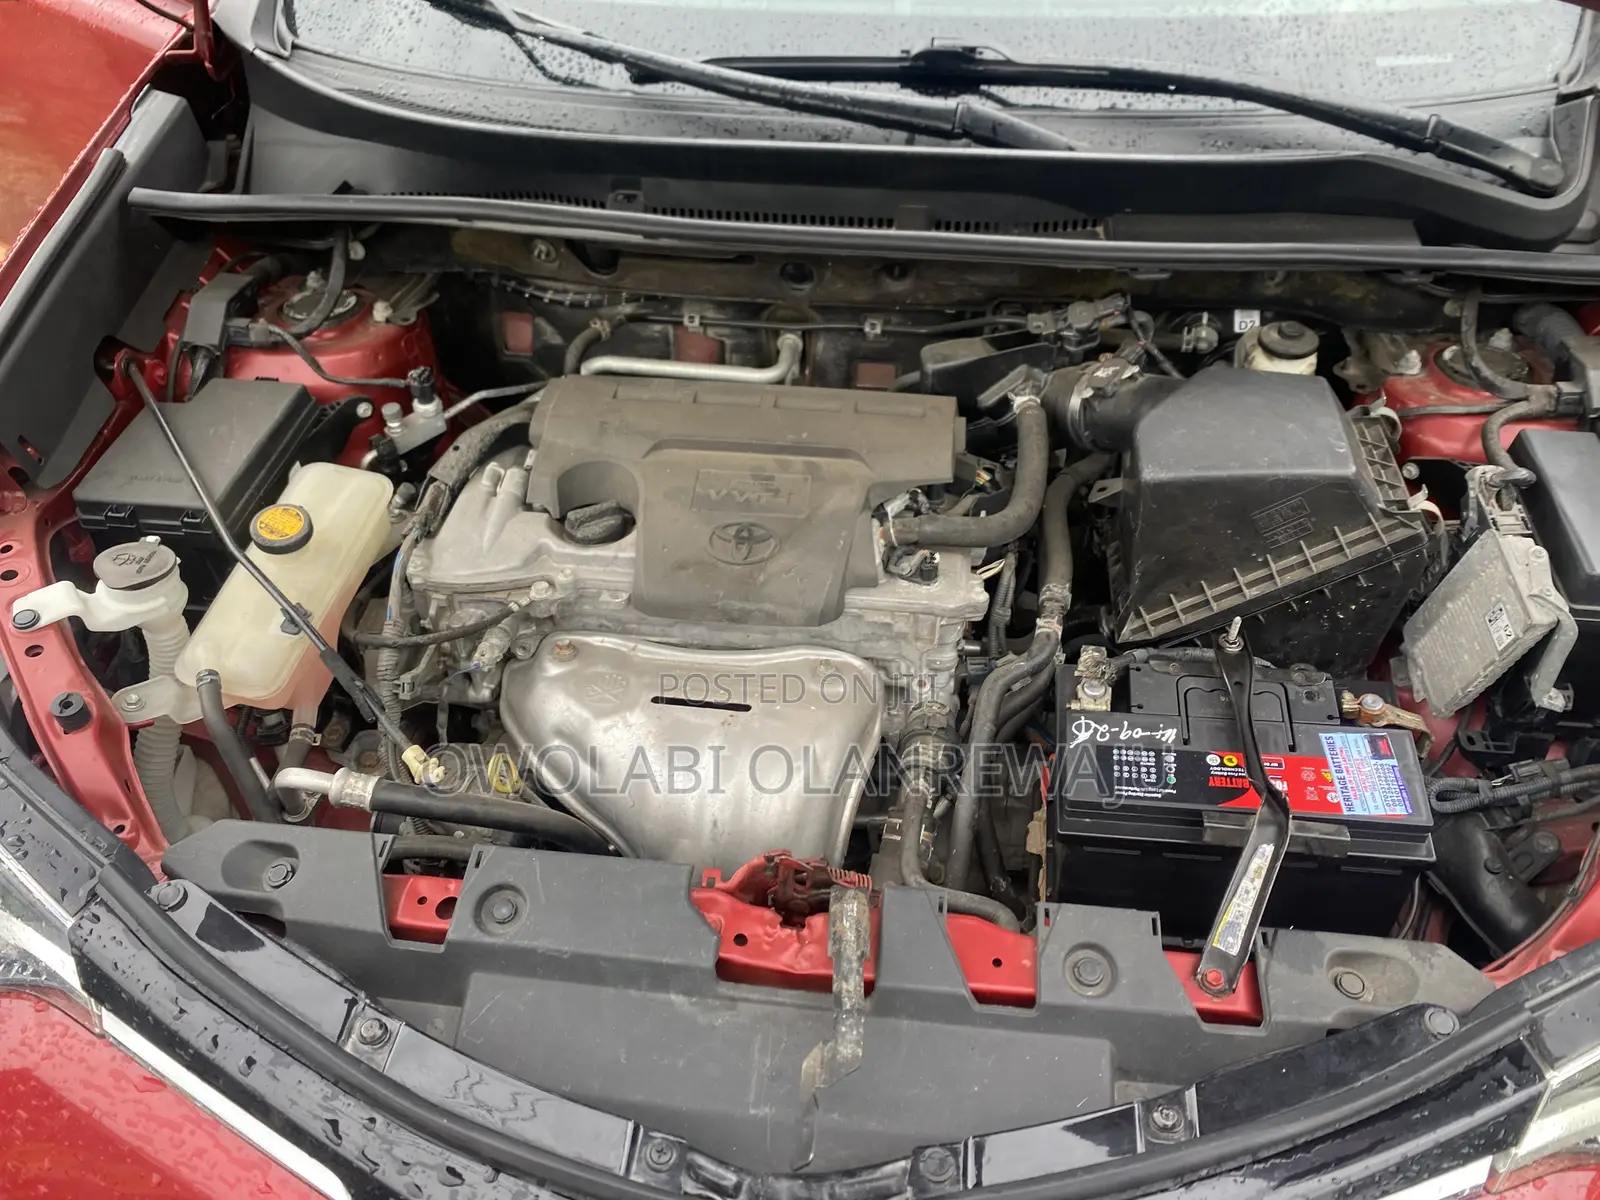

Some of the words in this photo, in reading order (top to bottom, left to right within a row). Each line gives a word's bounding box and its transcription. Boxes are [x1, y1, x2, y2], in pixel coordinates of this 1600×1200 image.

[1325, 736, 1344, 773] BATTERIES
[1208, 776, 1249, 788] BATTERY
[1337, 775, 1355, 812] HERITAGE
